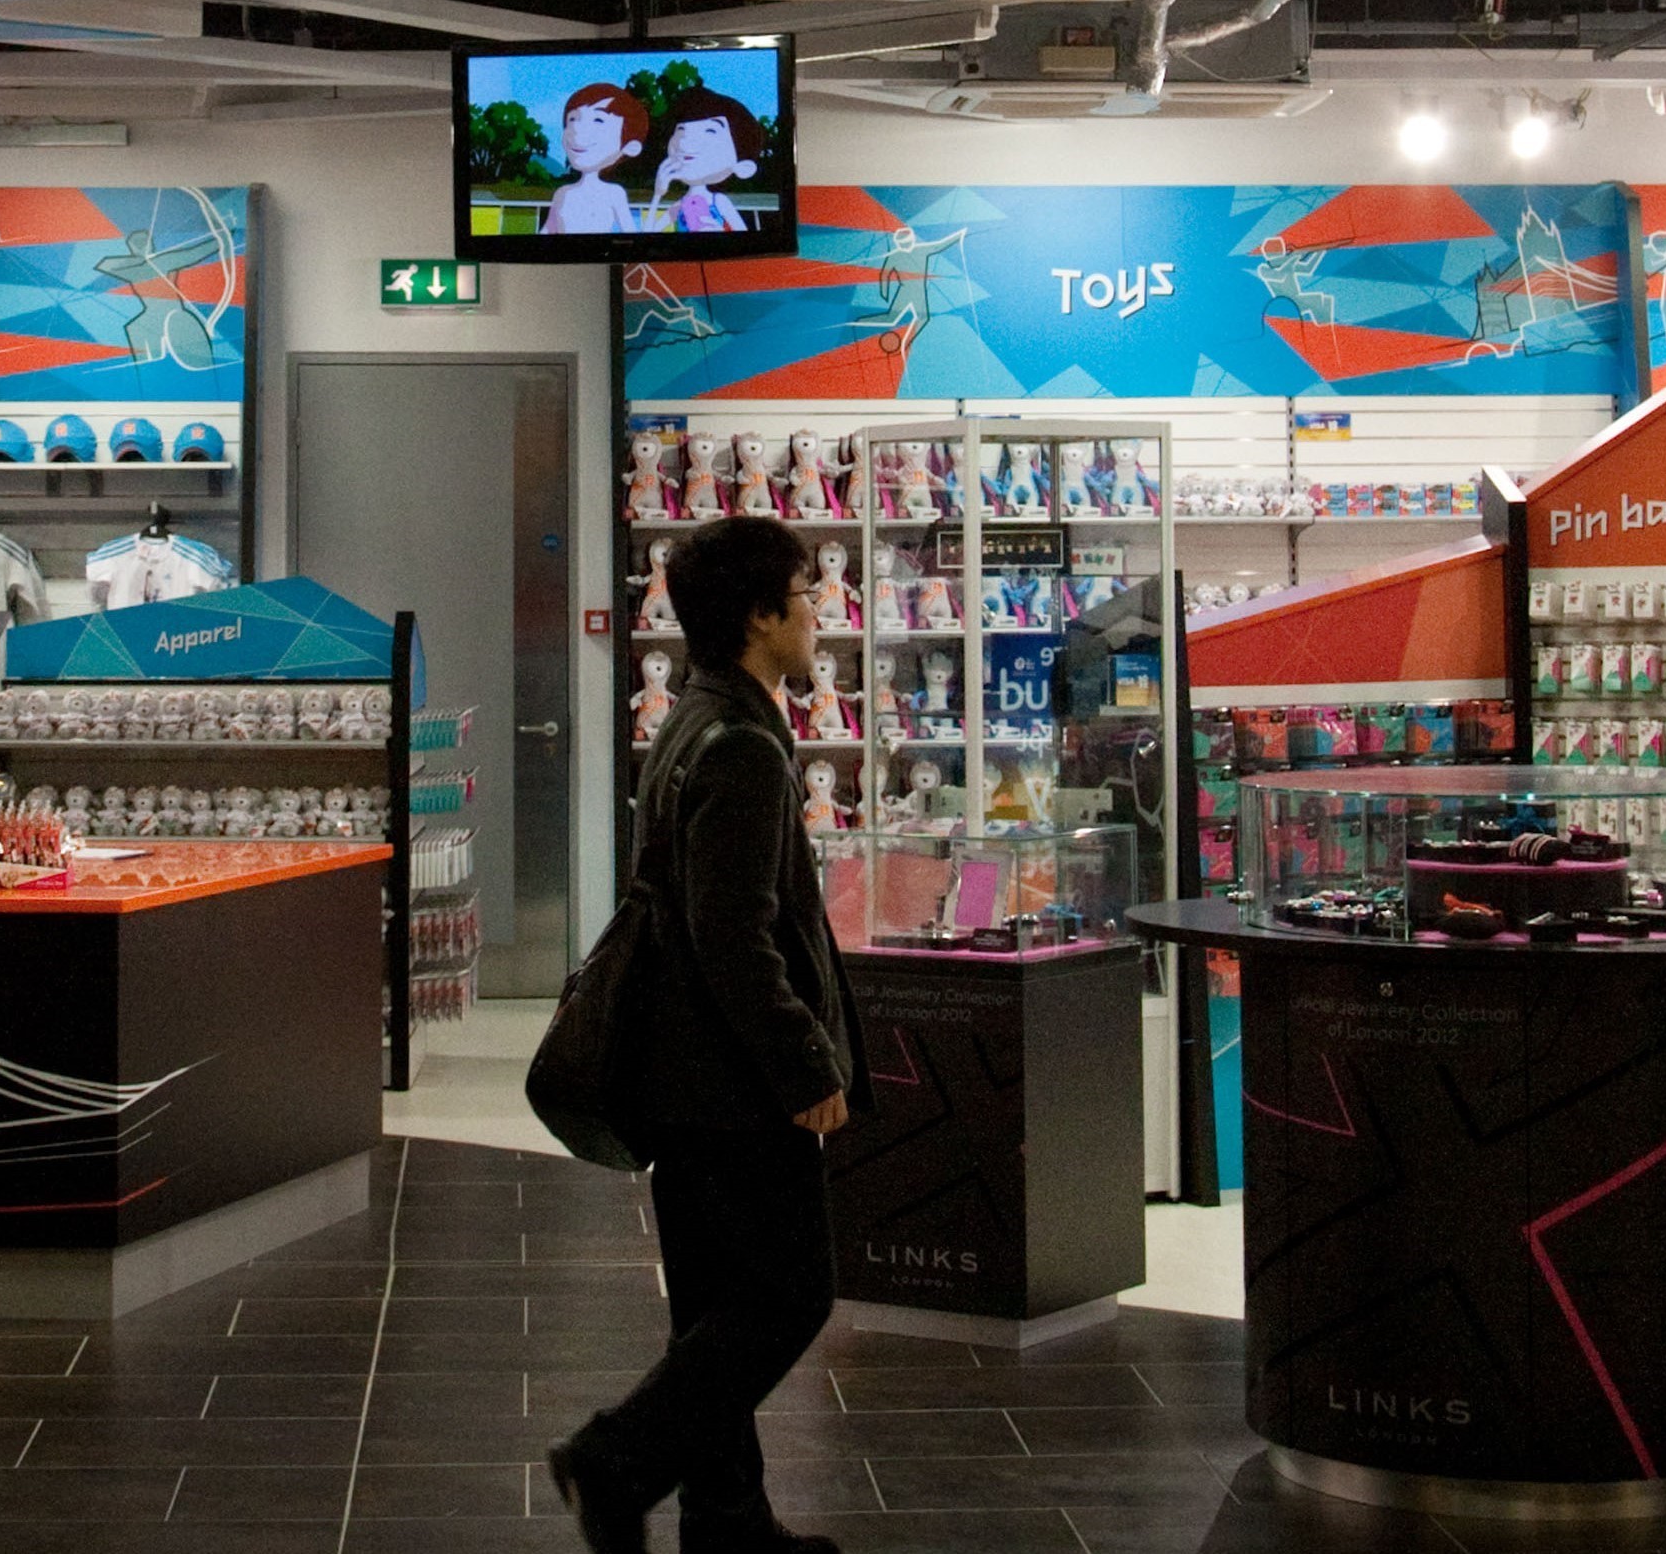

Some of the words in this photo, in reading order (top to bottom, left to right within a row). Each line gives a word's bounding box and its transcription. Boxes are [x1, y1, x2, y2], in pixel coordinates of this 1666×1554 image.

[1050, 261, 1176, 319] Toys
[1549, 502, 1609, 546] Pin
[154, 616, 244, 654] Apparel
[1420, 1002, 1519, 1023] Collection
[865, 1242, 980, 1274] LINKS
[1327, 1384, 1472, 1426] LINKS
